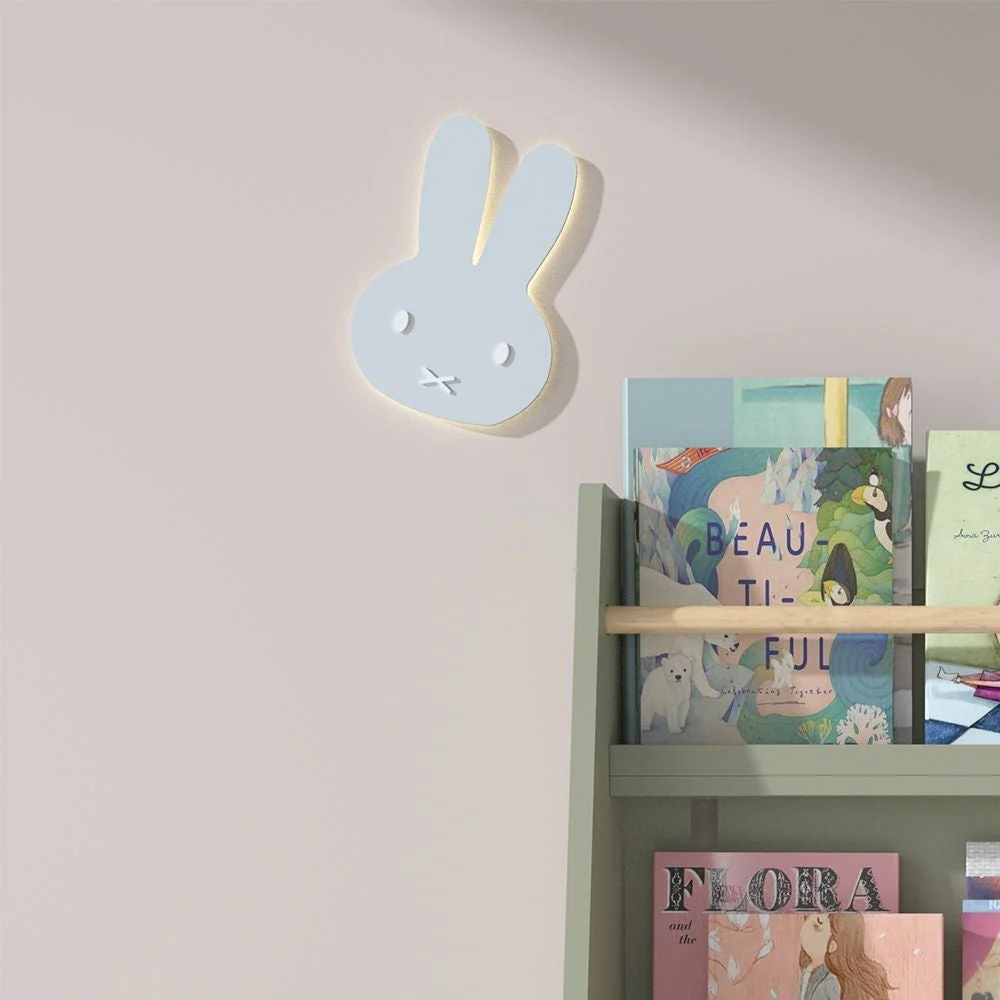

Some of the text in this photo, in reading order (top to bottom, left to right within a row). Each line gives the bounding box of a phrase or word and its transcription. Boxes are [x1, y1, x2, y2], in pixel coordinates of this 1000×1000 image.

[706, 522, 829, 555] BEAU-
[765, 637, 830, 671] FUL
[662, 866, 890, 913] FLORA
[669, 920, 692, 931] and
[679, 935, 697, 945] the
